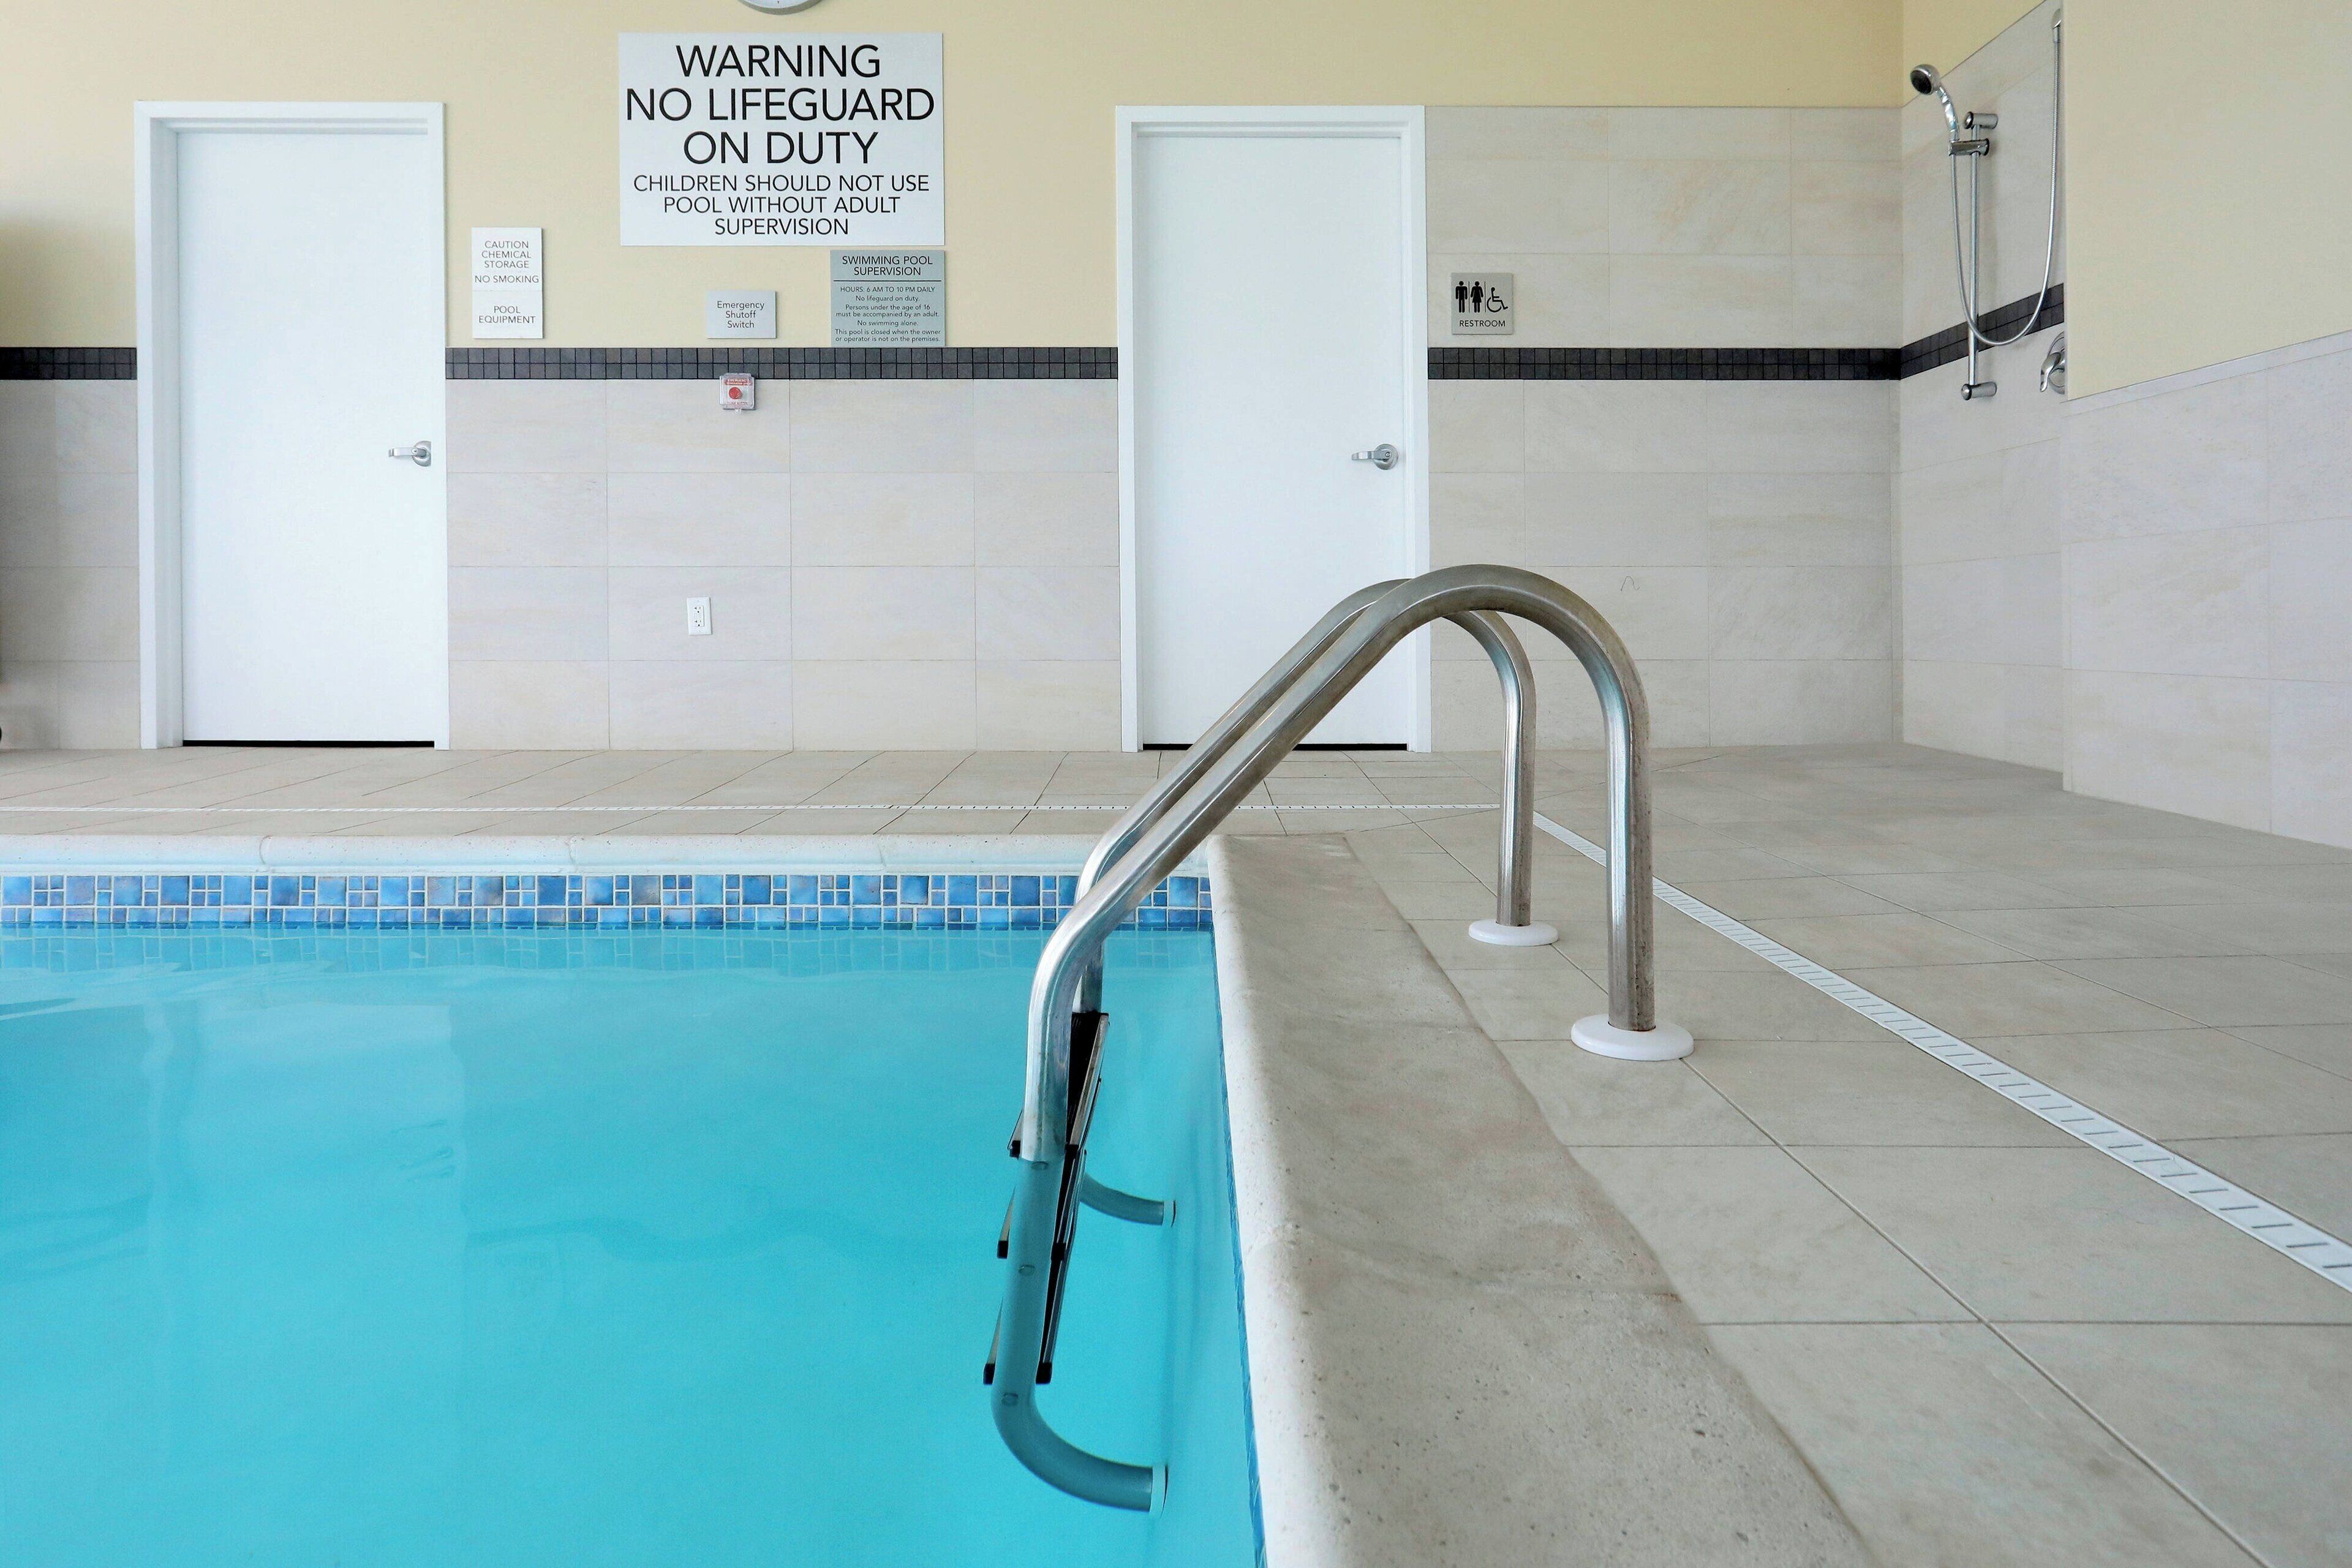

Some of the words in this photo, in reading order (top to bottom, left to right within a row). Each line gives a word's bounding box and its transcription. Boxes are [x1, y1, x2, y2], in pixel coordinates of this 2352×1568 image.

[676, 45, 880, 78] WARNING
[627, 88, 692, 121] NO
[710, 88, 934, 121] LIFEGUARD
[684, 131, 748, 164] ON
[767, 132, 878, 164] DUTY
[634, 175, 736, 191] CHILDREN
[745, 175, 831, 191] SHOULD
[840, 175, 884, 191] NOT
[892, 175, 929, 191] USE
[665, 197, 722, 213] POOL
[729, 197, 827, 213] WITHOUT
[834, 197, 900, 213] ADULT
[715, 219, 848, 235] SUPERVISION
[843, 256, 899, 265] SWIMMING
[904, 256, 933, 265] POOL
[717, 301, 764, 311] Emergency
